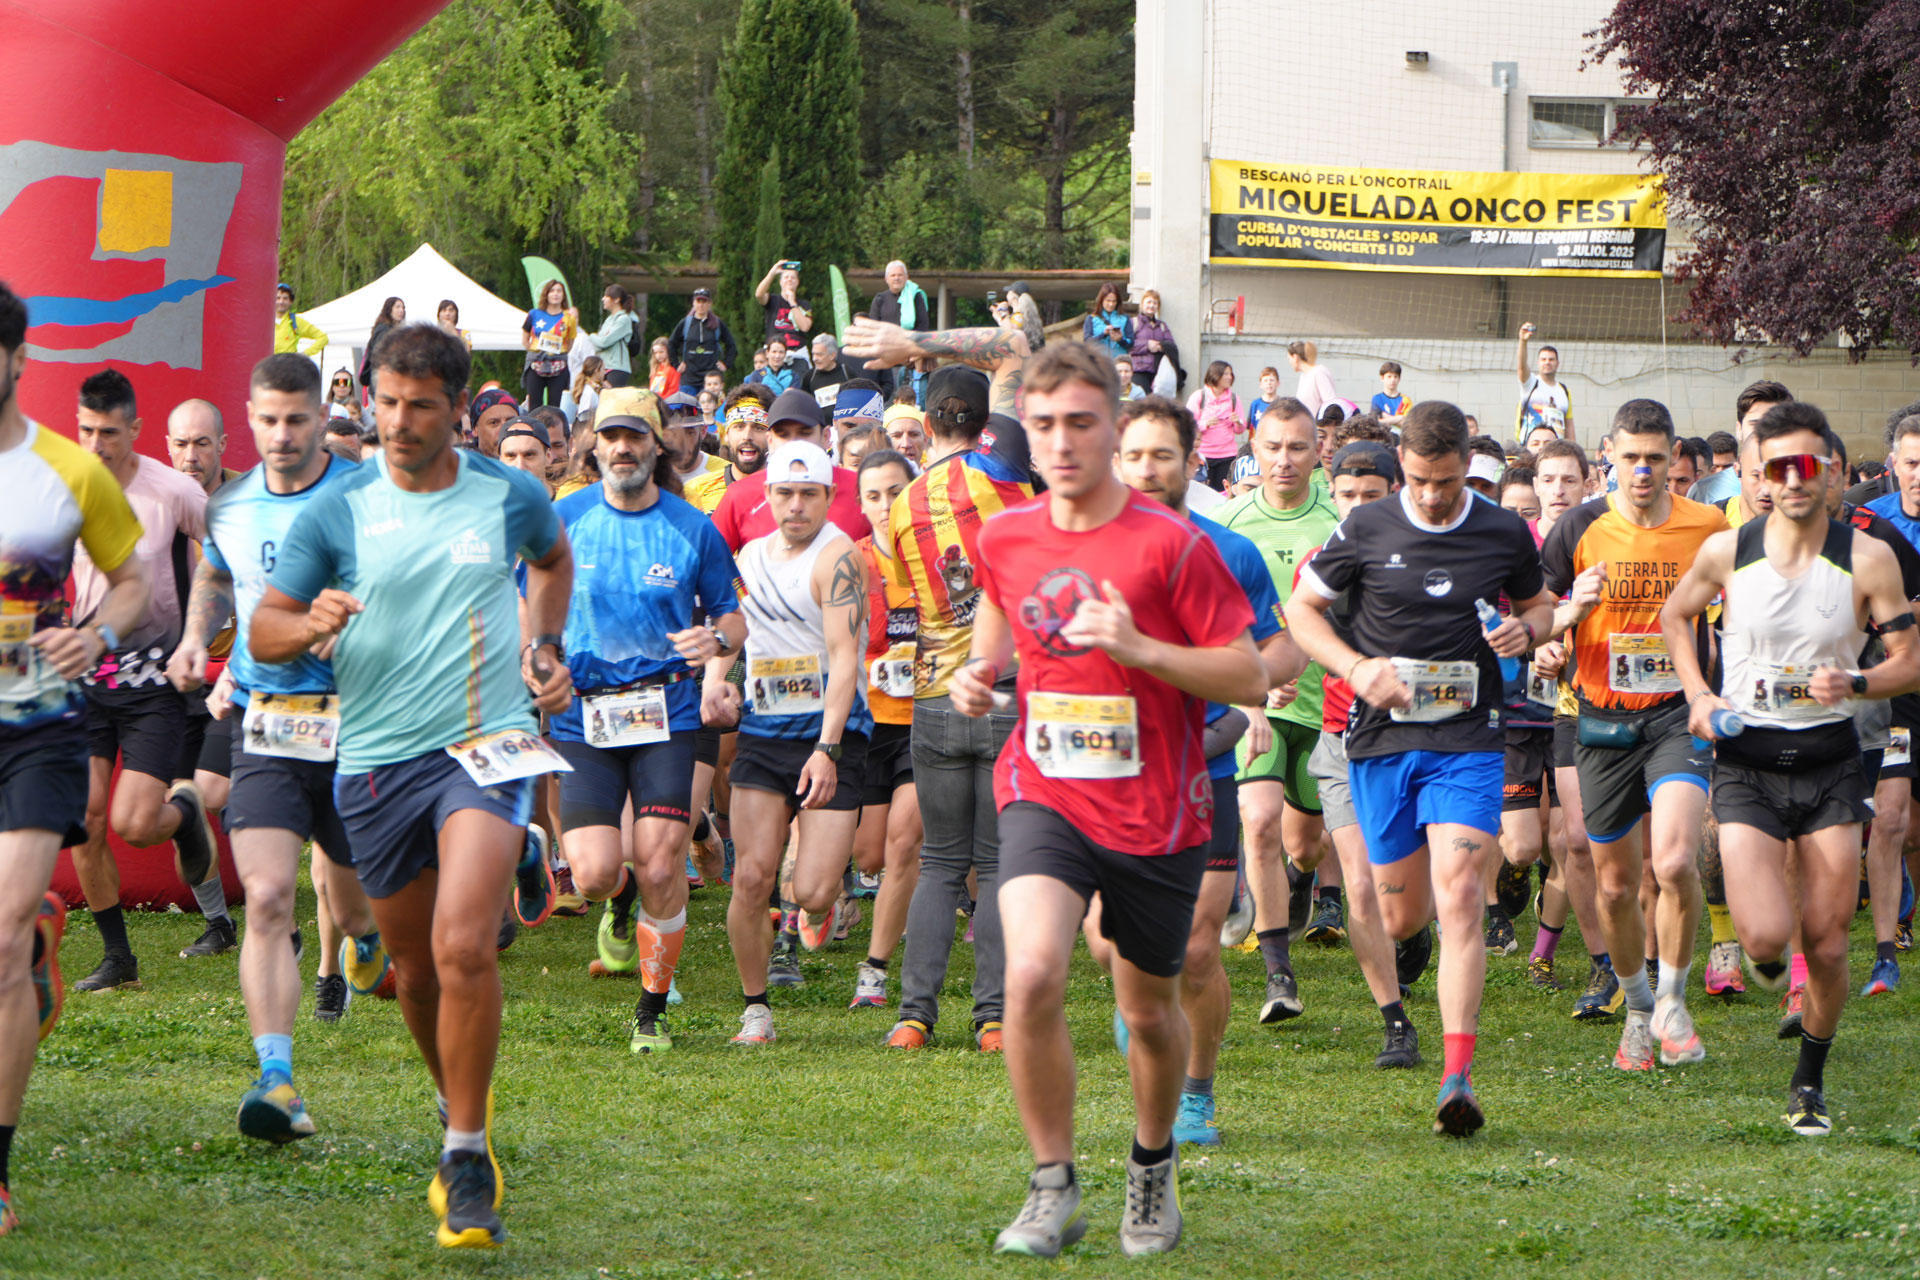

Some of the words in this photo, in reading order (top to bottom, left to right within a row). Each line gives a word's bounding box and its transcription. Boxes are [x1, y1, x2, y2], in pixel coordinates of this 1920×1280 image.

[1239, 168, 1312, 183] BESCANÓ
[1317, 173, 1345, 186] PER
[1350, 175, 1452, 190] L'ONCOTRAIL
[1239, 185, 1440, 221] MIQUELADA
[1450, 198, 1546, 223] ONCO
[1557, 199, 1637, 223] FEST
[1237, 221, 1285, 235] CURSA
[1287, 225, 1381, 242] D'OBSTACLES
[1391, 231, 1439, 244] SOPAR
[1534, 230, 1588, 244] ESPORTIVA
[1237, 234, 1302, 249] POPULAR
[1313, 239, 1387, 255] CONCERTS
[1399, 244, 1415, 256] DJ
[1571, 246, 1608, 257] JULIOL
[1609, 246, 1635, 257] 2025
[1616, 562, 1658, 577] TERRA
[1662, 562, 1678, 577] DE
[1608, 580, 1678, 599] VOLCAN
[777, 678, 812, 694] 582
[1432, 685, 1457, 700] 18
[624, 708, 646, 724] 41
[283, 718, 326, 736] 507
[1071, 729, 1117, 750] 601
